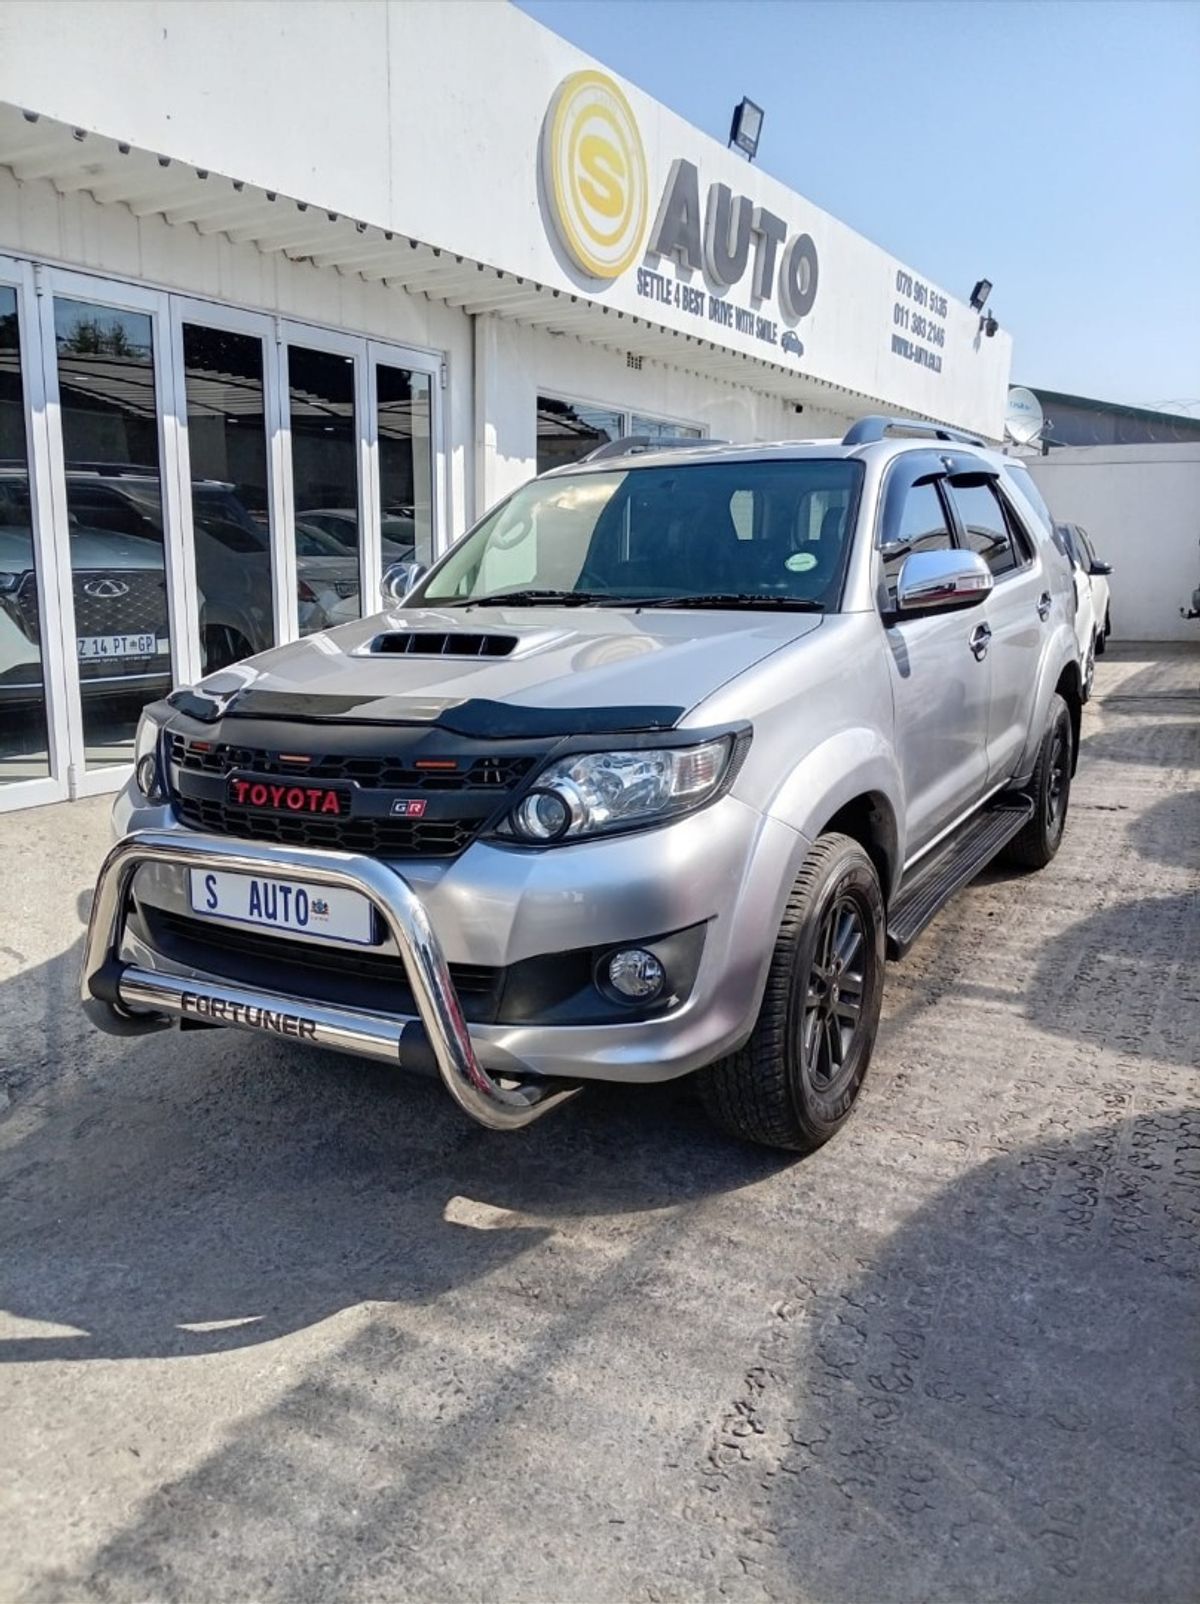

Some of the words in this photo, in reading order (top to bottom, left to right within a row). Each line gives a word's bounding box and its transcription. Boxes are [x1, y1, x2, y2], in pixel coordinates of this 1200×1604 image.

[647, 158, 820, 318] AUTO
[896, 269, 913, 298] 078
[636, 266, 673, 306] SETTLE
[673, 283, 681, 309] 4
[682, 285, 706, 317] BEST
[708, 295, 734, 328] DRIVE
[735, 305, 756, 336] WITH
[755, 315, 778, 346] SMILE
[894, 302, 910, 330] 011
[93, 639, 107, 654] 14
[113, 637, 127, 653] PT
[138, 636, 152, 651] GP
[235, 780, 341, 815] TOYOTA
[393, 801, 424, 816] GR
[205, 874, 219, 909] S
[249, 880, 310, 927] AUTO
[180, 990, 319, 1042] FORTUNER
